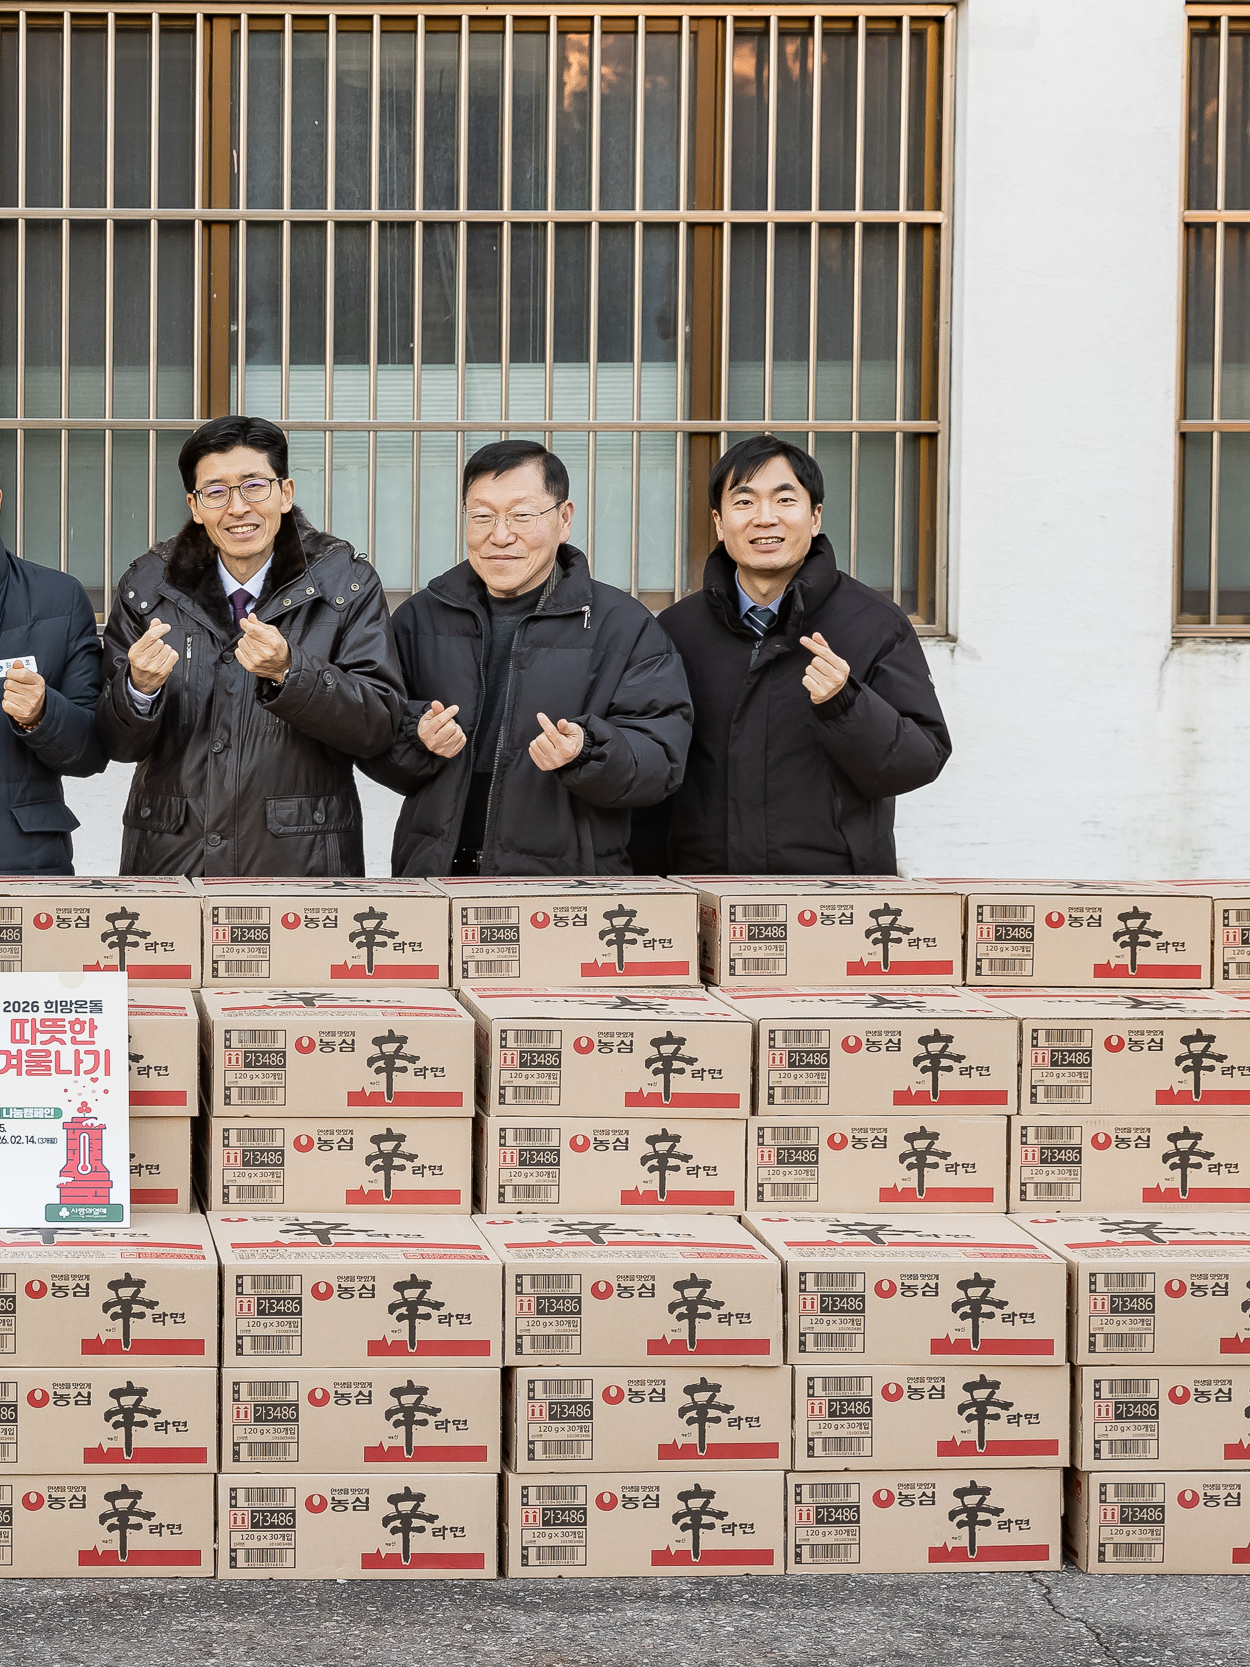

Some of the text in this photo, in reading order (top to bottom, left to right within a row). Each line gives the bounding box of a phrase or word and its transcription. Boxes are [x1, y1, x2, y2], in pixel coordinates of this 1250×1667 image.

[55, 915, 90, 929] 농심
[553, 914, 587, 927] 농심
[819, 912, 854, 926] 농심
[481, 928, 518, 942] 가3486
[749, 926, 786, 939] 가3486
[1155, 940, 1186, 954] 라면
[3, 999, 104, 1014] 2026 희망온돌
[10, 1017, 98, 1045] 따뜻한
[616, 1031, 634, 1039] 맛있게
[865, 1038, 901, 1053] 농심
[1127, 1037, 1164, 1052] 농심
[789, 1052, 828, 1066] 가3486
[1052, 1051, 1091, 1066] 가3486
[136, 1064, 170, 1078] 라면
[413, 1065, 446, 1080] 라면
[2, 1108, 55, 1118] 나눔캠페인
[850, 1135, 887, 1150] 농심
[1114, 1135, 1150, 1149] 농심
[778, 1149, 817, 1163] 가3486
[1041, 1148, 1080, 1163] 가3486
[411, 1164, 444, 1178] 라면
[336, 1275, 376, 1283] 인생을 맛있게
[616, 1283, 655, 1299] 농심
[899, 1282, 939, 1298] 농심
[1189, 1282, 1229, 1297] 농심
[538, 1298, 580, 1313] 가3486
[821, 1296, 863, 1312] 가3486
[151, 1311, 186, 1327] 라면
[52, 1391, 91, 1407] 농심
[906, 1385, 945, 1400] 농심
[1193, 1388, 1232, 1403] 농심
[829, 1400, 871, 1416] 가3486
[1116, 1403, 1157, 1418] 가3486
[434, 1418, 469, 1433] 라면
[917, 1482, 936, 1490] 맛있게
[47, 1494, 86, 1510] 농심
[330, 1497, 369, 1512] 농심
[1202, 1492, 1241, 1508] 농심
[252, 1512, 294, 1527] 가3486
[1121, 1507, 1163, 1522] 가3486
[720, 1522, 755, 1537] 라면
